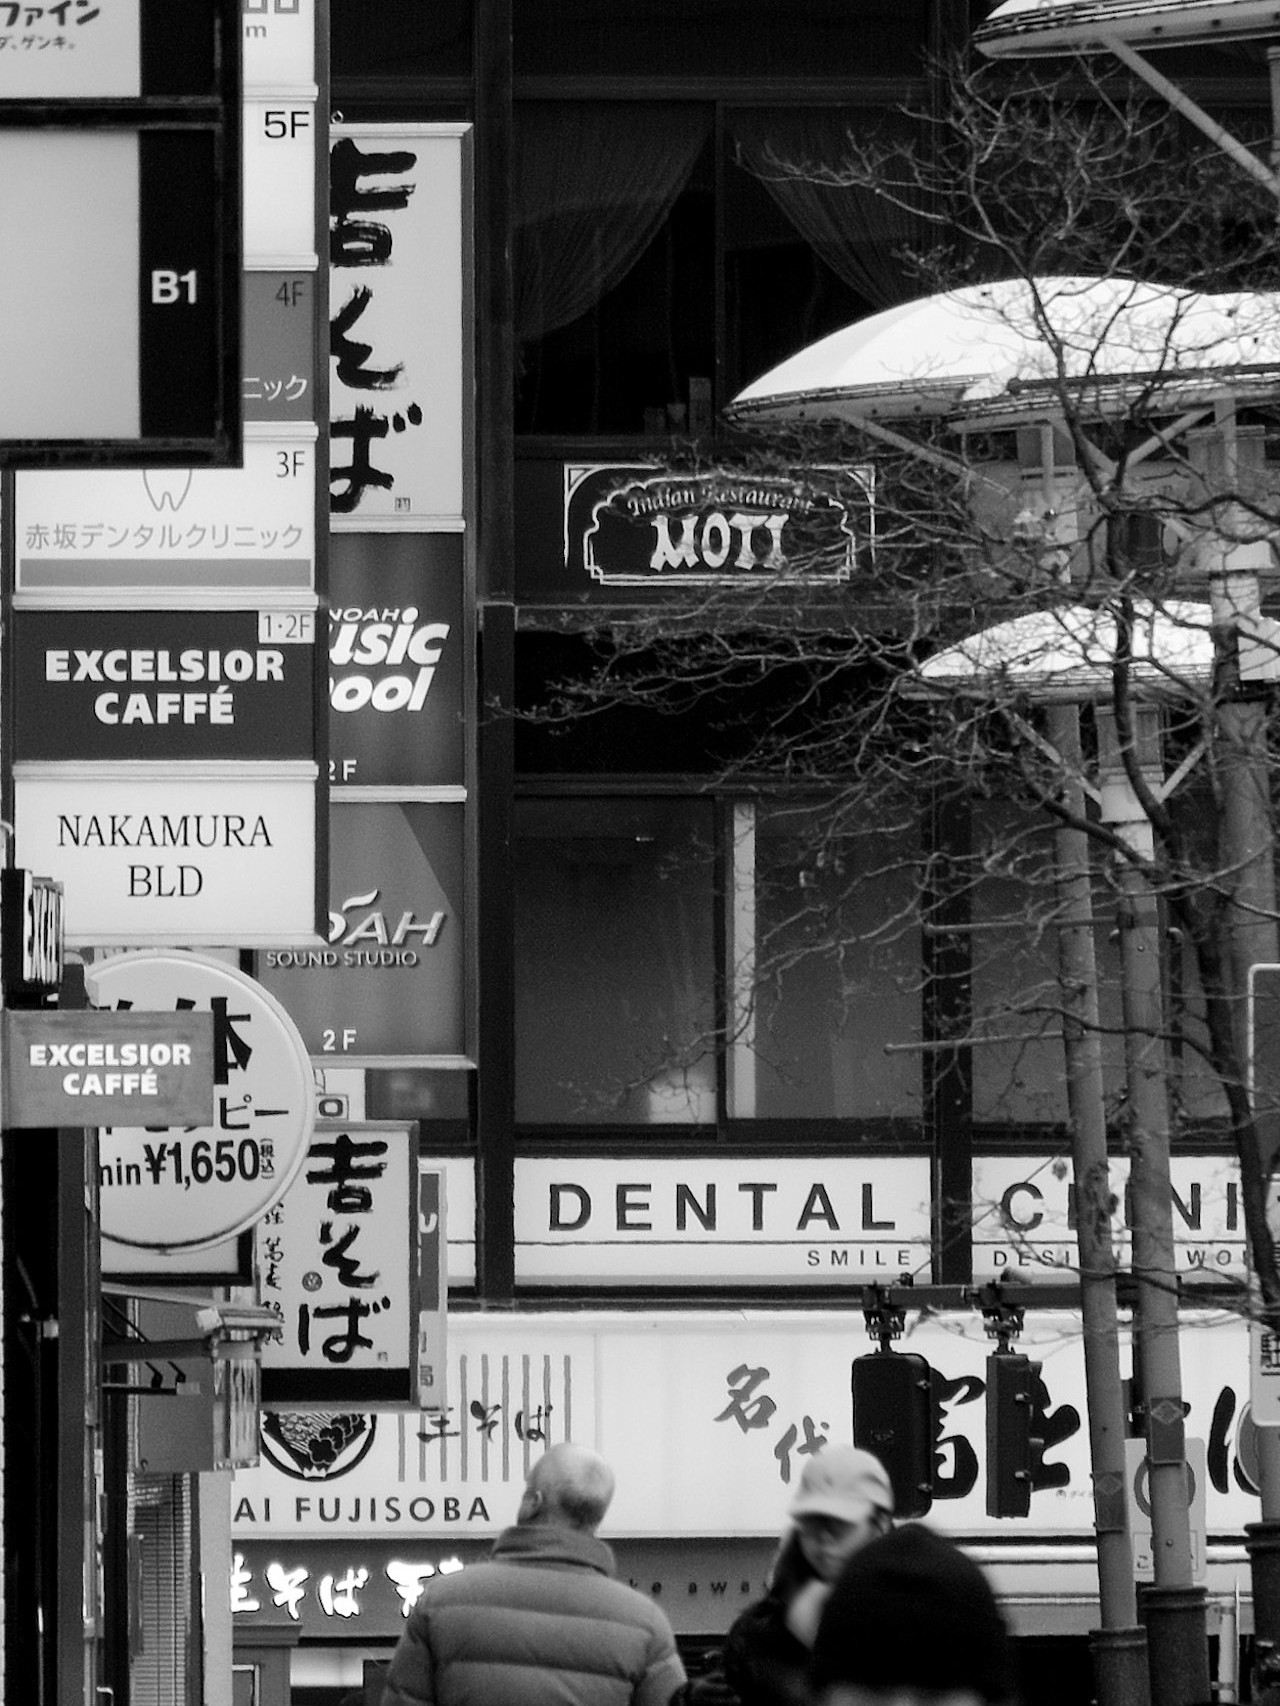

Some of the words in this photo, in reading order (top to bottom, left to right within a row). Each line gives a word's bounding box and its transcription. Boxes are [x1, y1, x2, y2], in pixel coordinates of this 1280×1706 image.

[263, 110, 311, 139] 5F
[150, 270, 199, 305] B1
[274, 280, 305, 307] 4F
[275, 450, 306, 479] 3F
[25, 523, 304, 552] 赤坂デンタルクリニック
[649, 512, 790, 572] MOTI
[329, 606, 451, 666] usic
[44, 649, 285, 683] EXCELSIOR
[93, 686, 235, 725] CAFFÉ
[56, 813, 273, 849] NAKAMURA
[126, 863, 204, 898] BLD
[266, 949, 338, 968] SOUND
[342, 949, 418, 968] STUDIO
[29, 1043, 192, 1068] EXCELSIOR
[62, 1068, 159, 1096] CAFFÉ
[548, 1181, 898, 1233] DENTAL
[297, 1135, 392, 1364] 吉そば
[807, 1249, 912, 1267] SMILE
[295, 1495, 491, 1524] FUJISOBA
